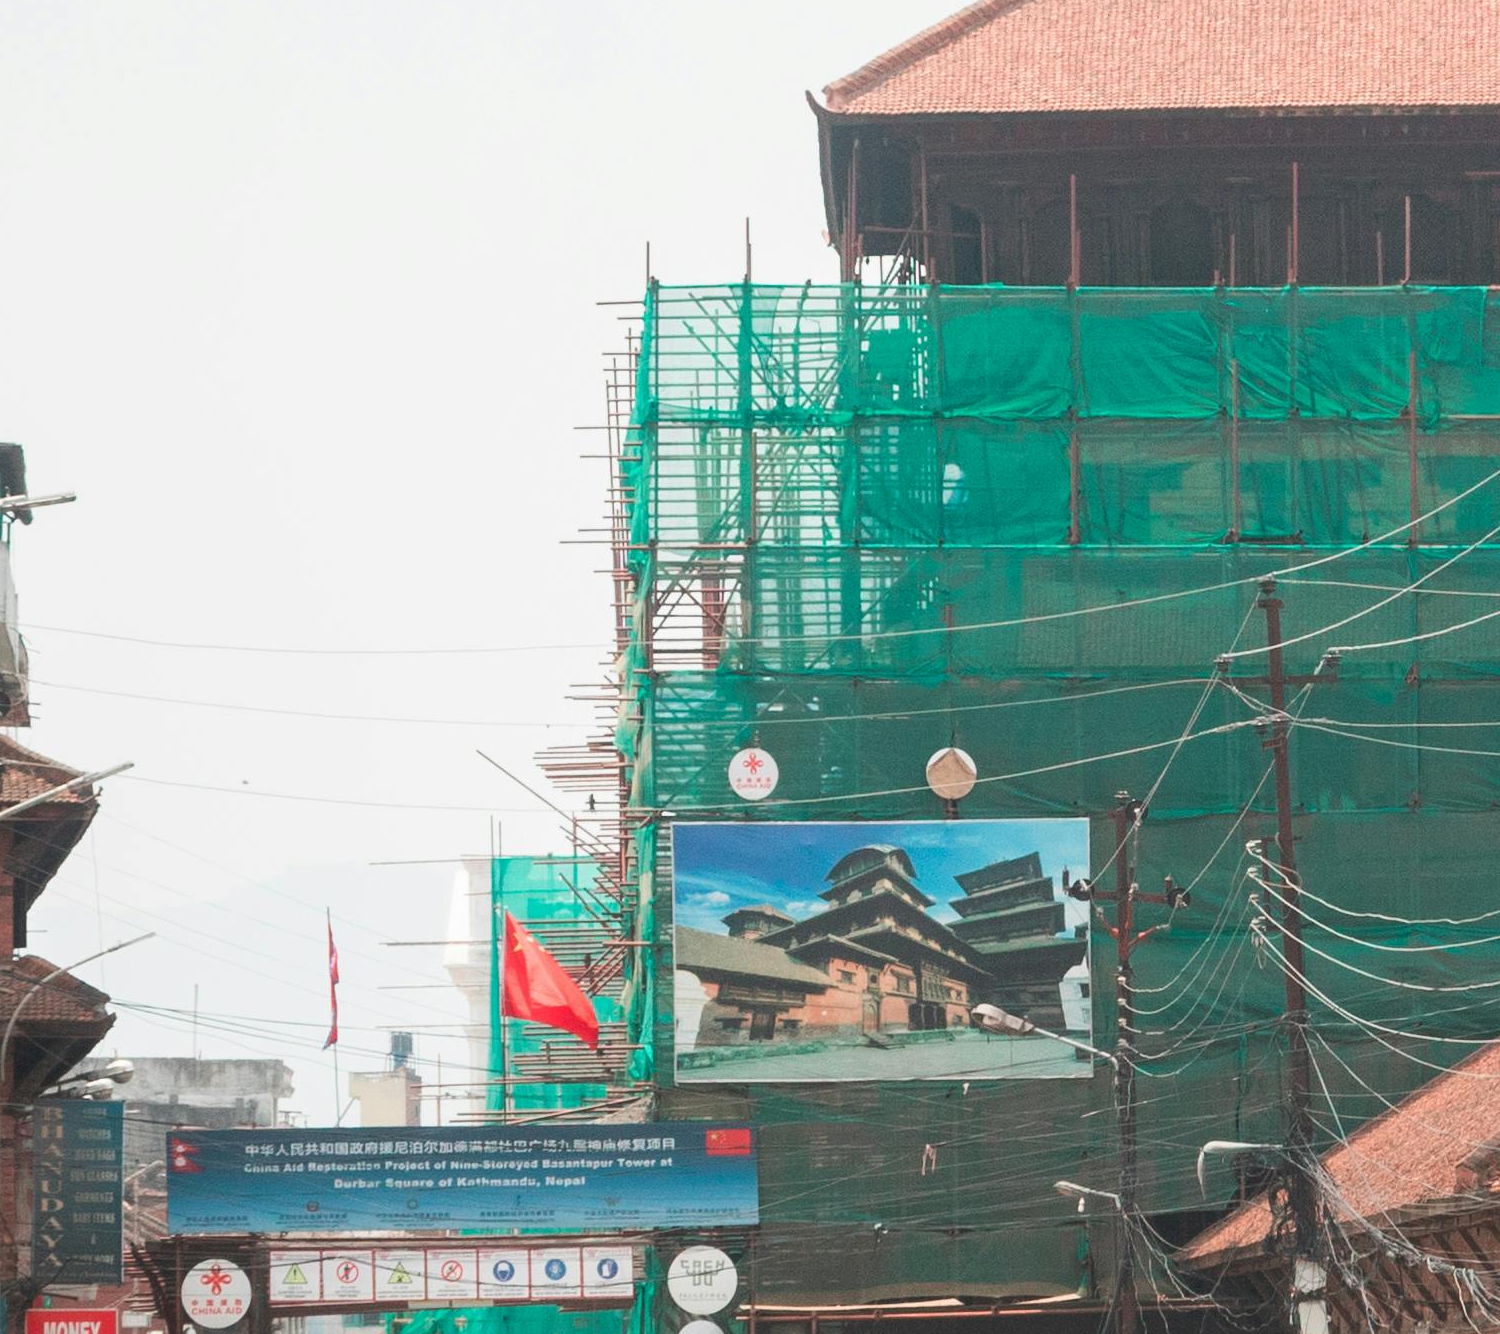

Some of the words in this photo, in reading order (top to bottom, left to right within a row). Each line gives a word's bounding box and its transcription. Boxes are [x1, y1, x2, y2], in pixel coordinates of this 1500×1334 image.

[244, 1163, 280, 1174] China
[283, 1162, 304, 1173] Aid
[307, 1161, 381, 1174] Restoration
[384, 1160, 431, 1173] Project
[434, 1159, 447, 1171] of
[450, 1158, 539, 1172] Nine-Storeyed
[542, 1158, 614, 1170] Basantapur
[617, 1157, 656, 1168] Tower
[660, 1157, 673, 1167] at
[333, 1178, 380, 1189] Durbar
[385, 1177, 434, 1189] Square
[438, 1177, 453, 1188] of
[457, 1176, 541, 1188] Kathmandu,
[545, 1176, 586, 1187] Nepal
[191, 1307, 222, 1316] CHINA
[225, 1307, 243, 1315] AID
